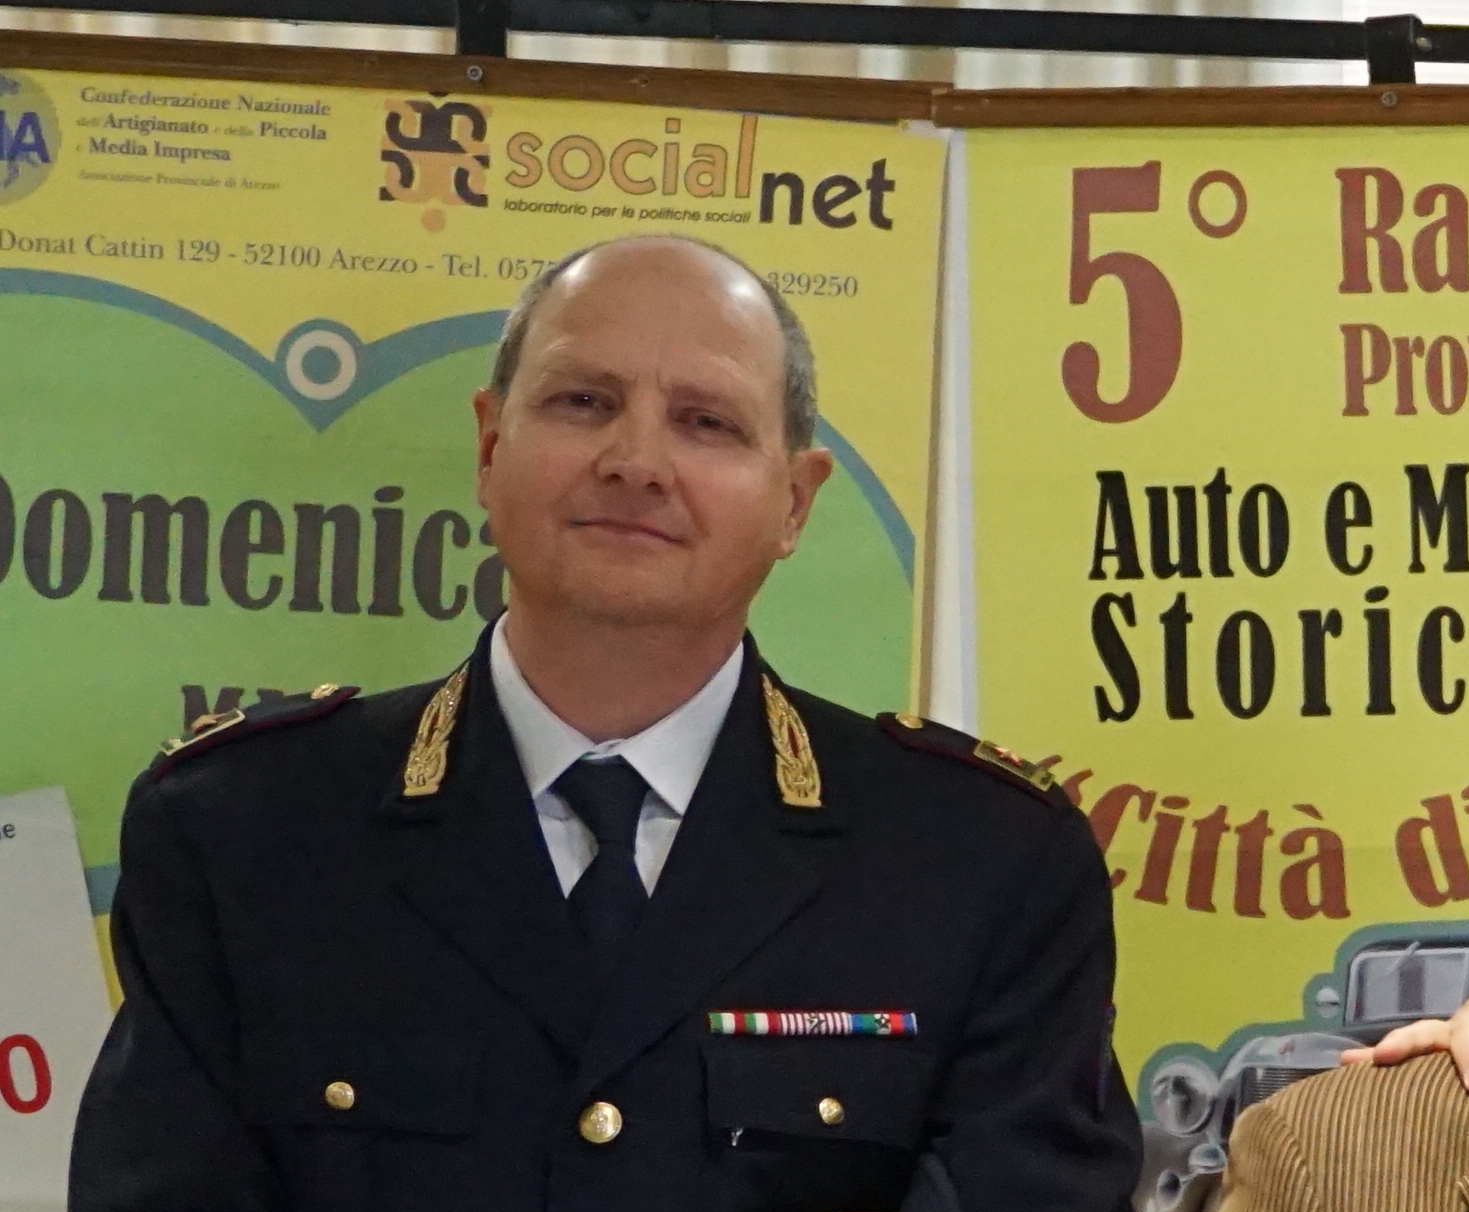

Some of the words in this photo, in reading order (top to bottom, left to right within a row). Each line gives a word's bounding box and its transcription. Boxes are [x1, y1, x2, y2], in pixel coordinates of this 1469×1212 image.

[80, 86, 232, 111] Confederazione
[236, 94, 331, 116] Nazionale
[103, 112, 209, 135] Artigianato
[259, 121, 327, 140] Piccola
[88, 136, 148, 156] Media
[154, 140, 231, 163] Impresa
[503, 198, 588, 217] laboratorio
[591, 205, 618, 219] per
[621, 206, 634, 219] le
[638, 207, 701, 223] politiche
[704, 209, 752, 224] sociali
[86, 233, 164, 261] Cattin
[177, 238, 221, 264] 129
[243, 243, 322, 269] 52100
[328, 247, 418, 276] Arezzo
[442, 254, 488, 279] Tel.
[1088, 467, 1291, 582] Auto
[1324, 480, 1374, 577] e
